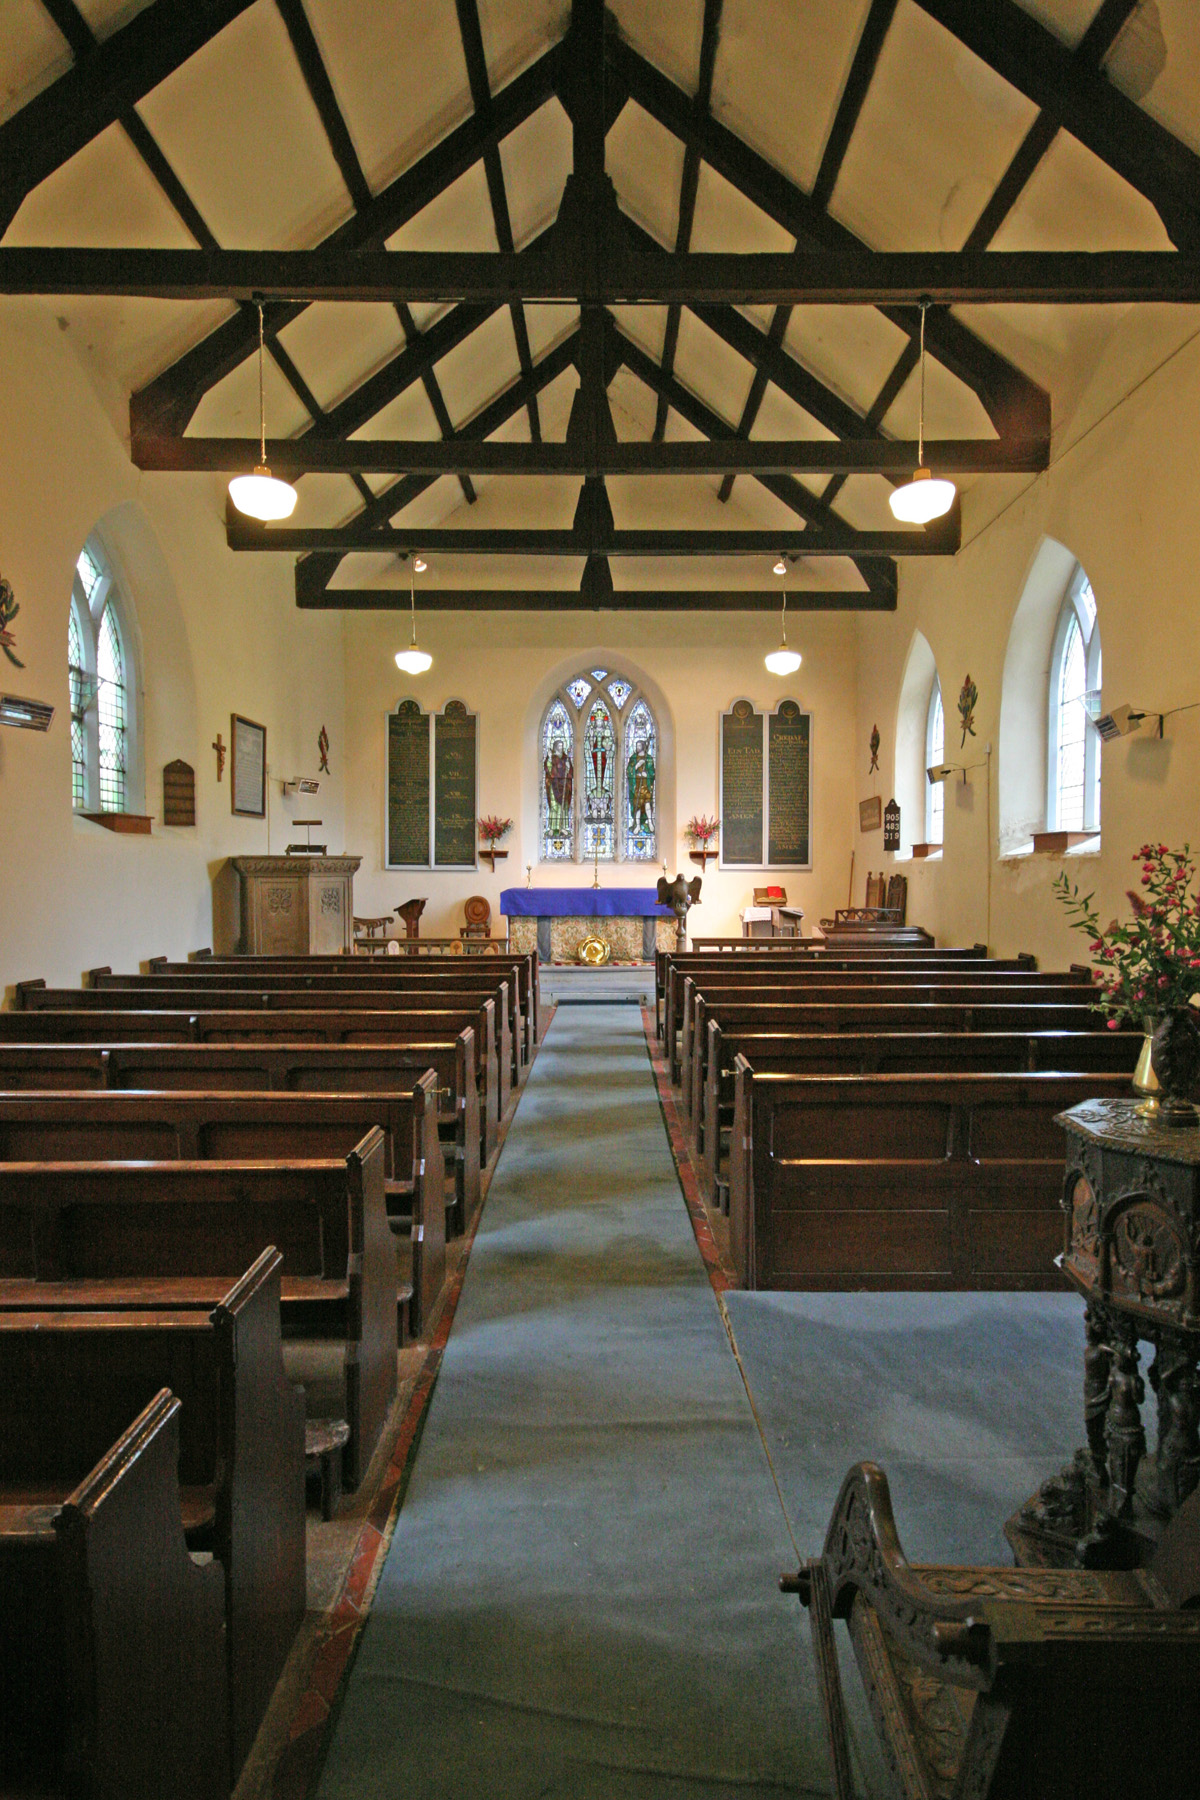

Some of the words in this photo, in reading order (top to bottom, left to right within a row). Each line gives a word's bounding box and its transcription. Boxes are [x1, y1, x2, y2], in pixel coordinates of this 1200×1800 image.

[885, 813, 900, 821] 905
[885, 822, 900, 831] 483
[884, 832, 900, 840] 319
